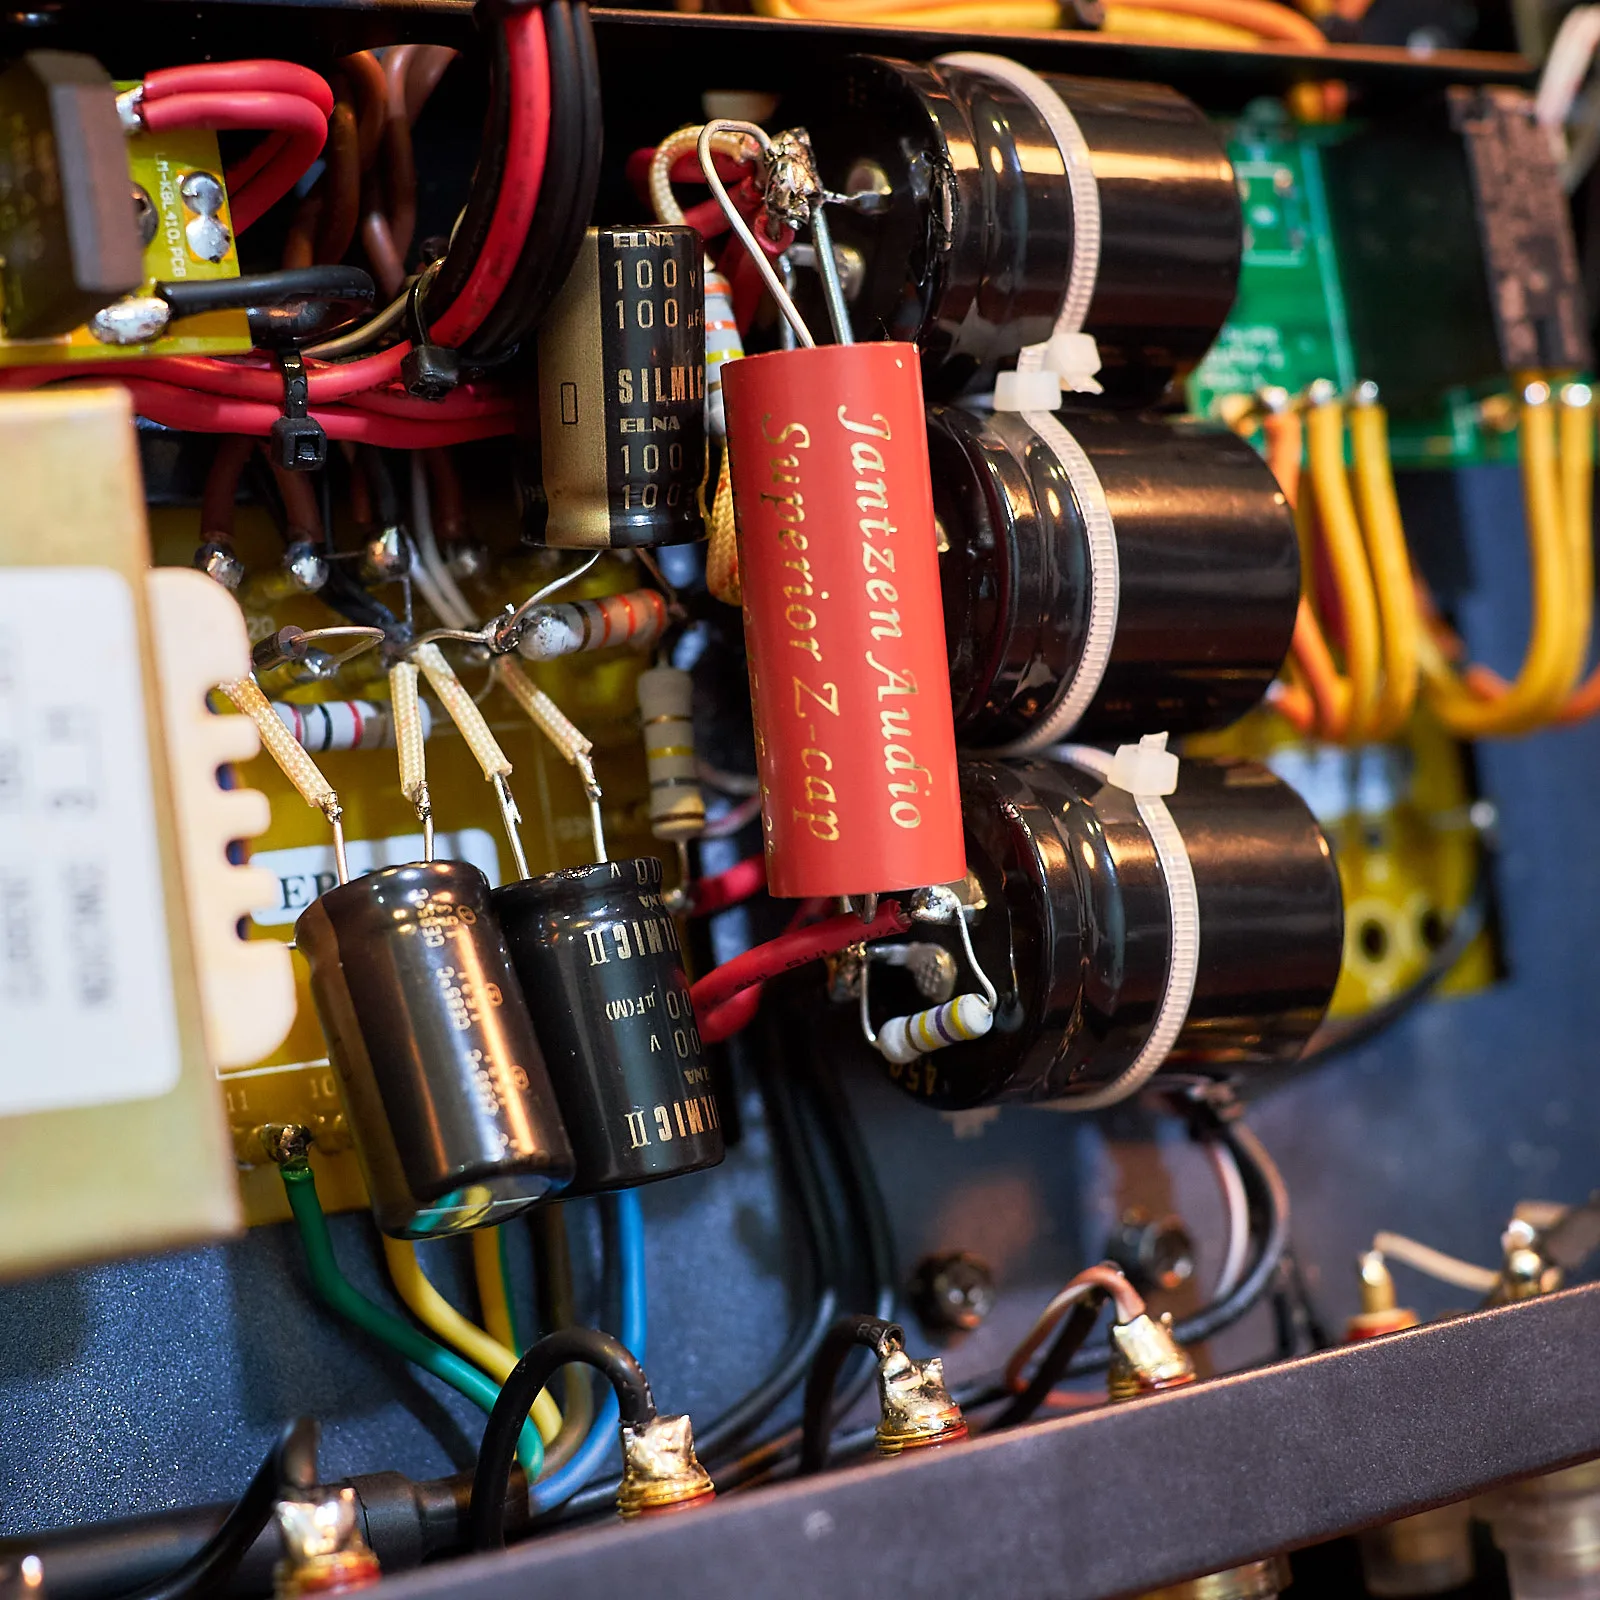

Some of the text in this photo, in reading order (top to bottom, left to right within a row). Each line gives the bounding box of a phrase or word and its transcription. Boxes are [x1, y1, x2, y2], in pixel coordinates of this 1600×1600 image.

[613, 232, 675, 248] ELNA
[614, 259, 678, 291] 100
[615, 299, 679, 330] 100
[618, 366, 705, 404] SILMIC
[620, 416, 681, 433] ELNA
[620, 443, 683, 475] 100
[622, 483, 682, 510] 100
[761, 413, 842, 843] Superior Z-cap
[838, 404, 935, 830] Jantzen Audio
[612, 916, 682, 960] ILMIC
[653, 1094, 720, 1142] ILMIC
